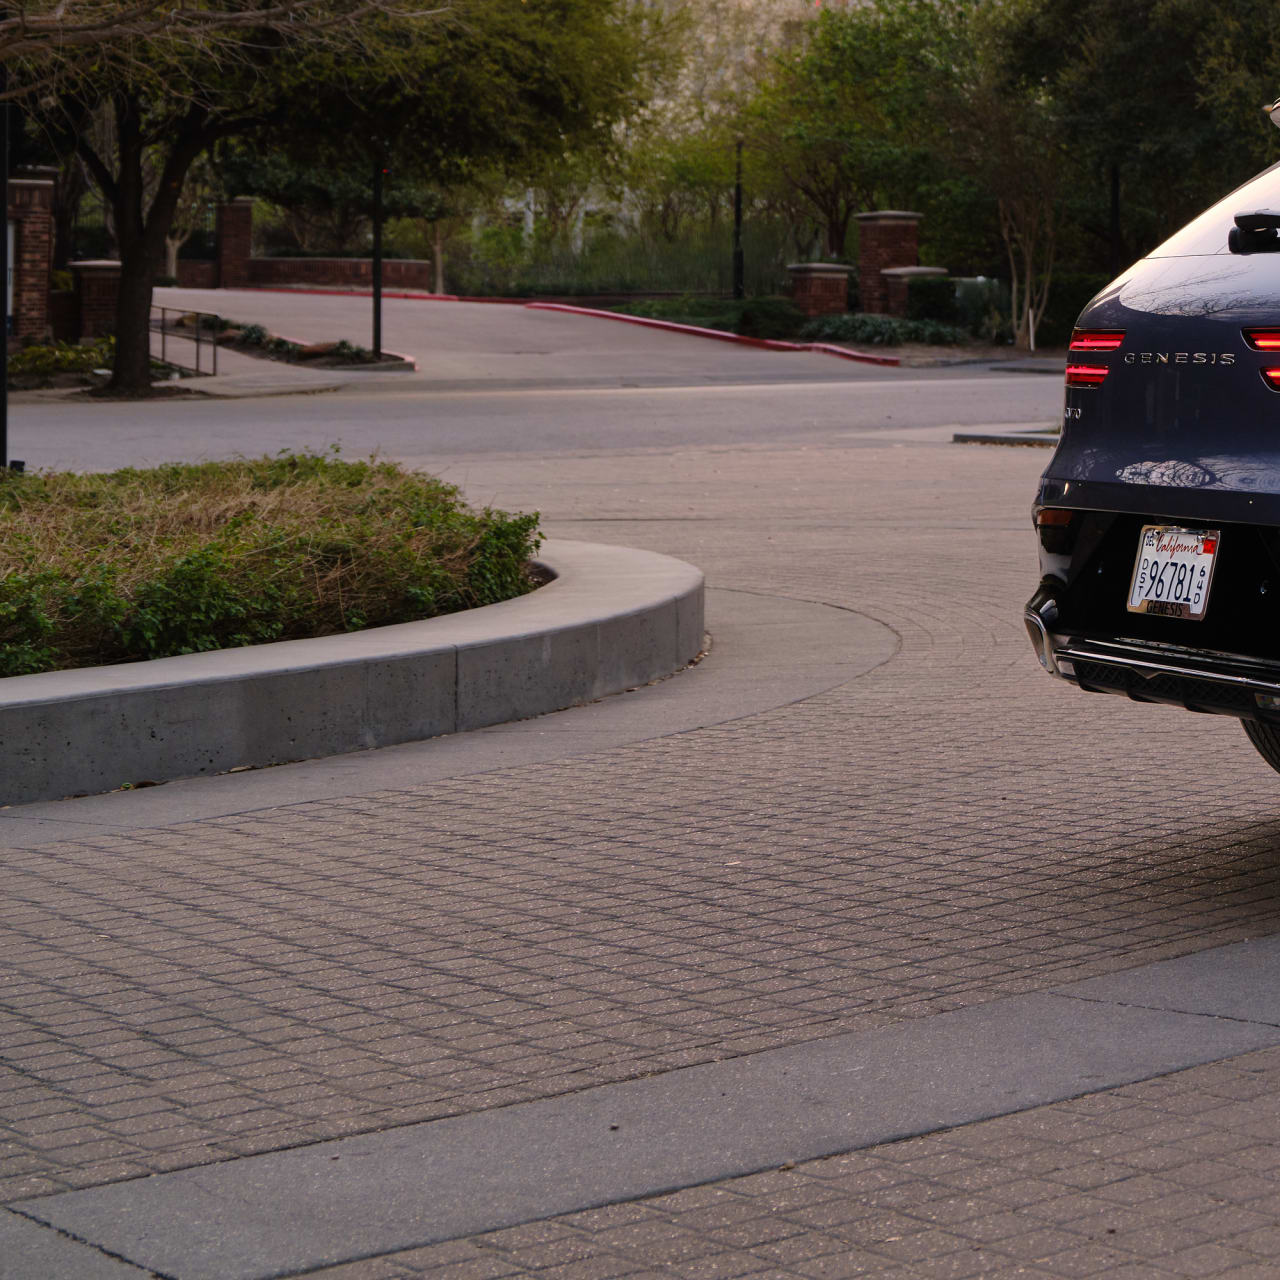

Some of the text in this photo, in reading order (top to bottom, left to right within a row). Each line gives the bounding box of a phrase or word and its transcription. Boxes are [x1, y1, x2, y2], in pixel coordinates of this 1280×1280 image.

[1124, 352, 1236, 365] GENESIS
[1156, 533, 1199, 559] California
[1145, 560, 1195, 603] 96781
[1146, 600, 1183, 617] GENESIS
